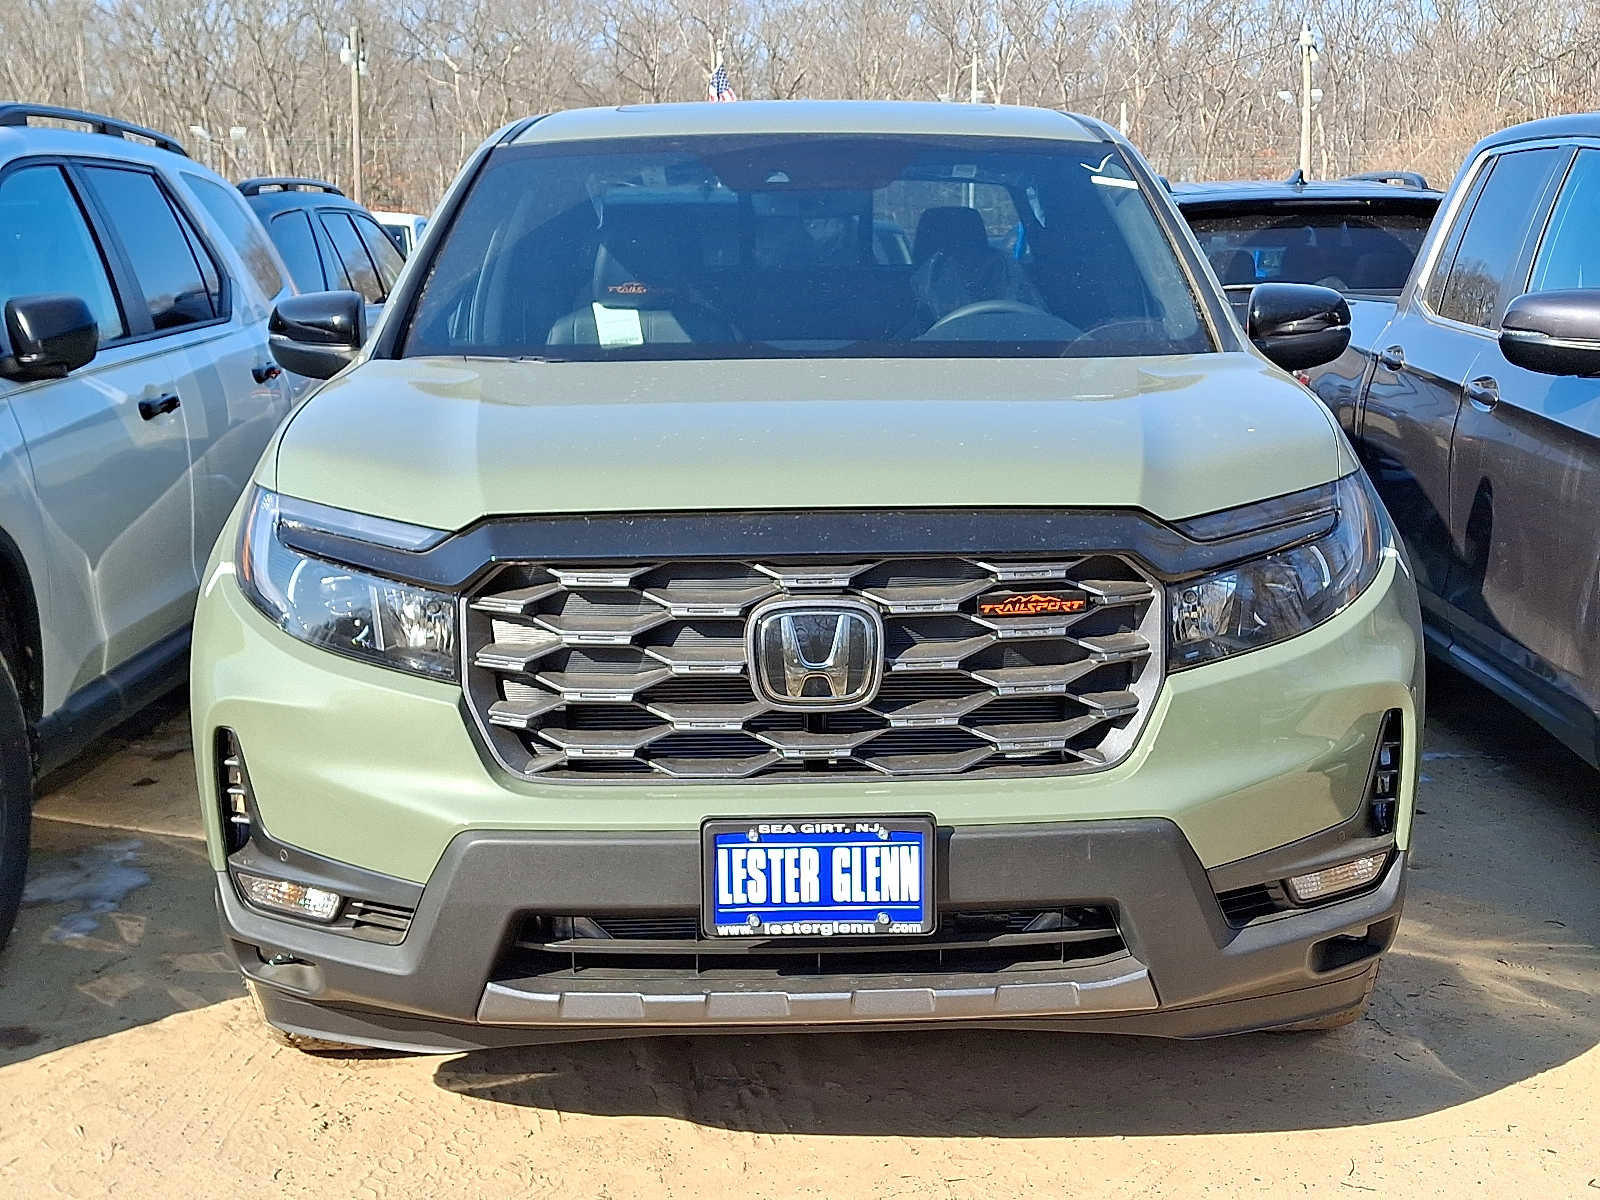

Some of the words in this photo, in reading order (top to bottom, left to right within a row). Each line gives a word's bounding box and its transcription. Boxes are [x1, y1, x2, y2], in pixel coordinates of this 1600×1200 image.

[980, 600, 1084, 615] TRAILSPORT
[758, 823, 796, 834] SEA
[717, 846, 821, 905] LESTER
[831, 845, 921, 904] GLENN
